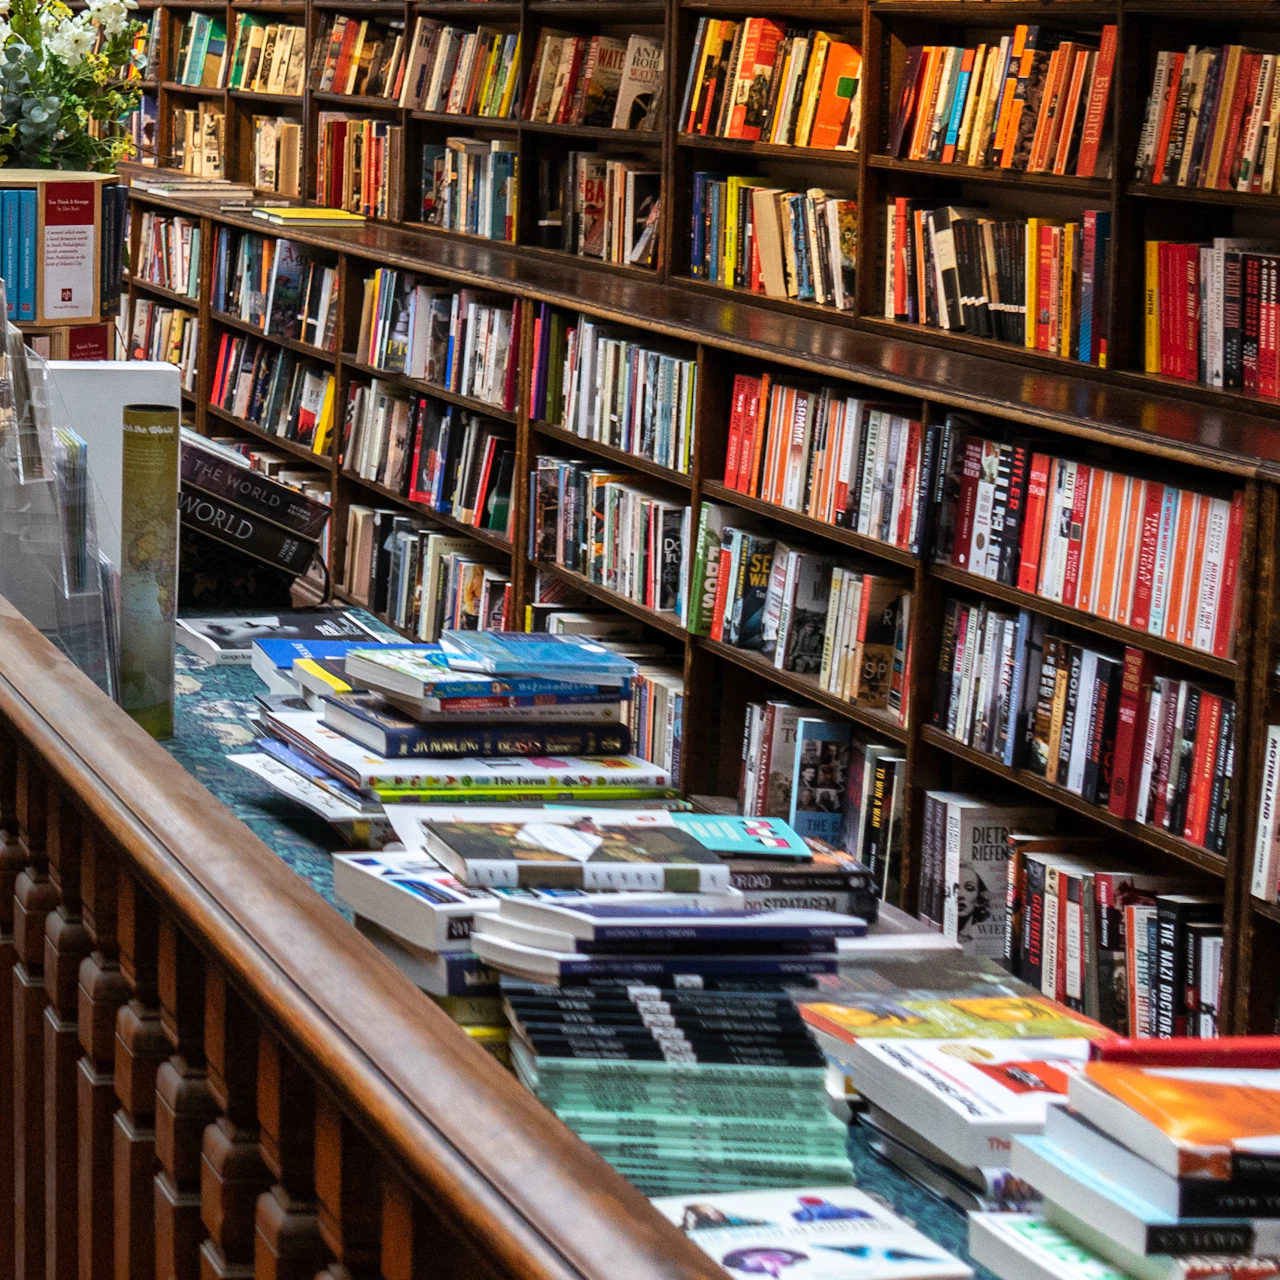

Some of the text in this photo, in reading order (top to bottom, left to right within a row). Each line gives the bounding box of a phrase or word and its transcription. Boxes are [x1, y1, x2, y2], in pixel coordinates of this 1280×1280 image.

[1255, 60, 1269, 106] DEIGHTON
[1083, 75, 1110, 145] Bismarck
[1269, 269, 1277, 307] GERMAN
[1268, 308, 1276, 350] REQUIEM
[792, 399, 808, 446] SOMME
[869, 423, 880, 465] GREAT
[192, 460, 282, 507] THE WORLD
[1009, 446, 1025, 510] HITLER
[1028, 485, 1046, 496] STALIN
[1030, 471, 1047, 481] HITLER
[1066, 472, 1075, 492] NOT
[179, 492, 254, 540] WORLD
[287, 508, 310, 522] EDITION
[289, 504, 312, 517] SECOND
[1163, 506, 1172, 534] WOMEN
[278, 539, 292, 559] TIMES
[285, 541, 300, 563] BOOKS
[1213, 515, 1225, 556] ANTONY
[1204, 562, 1219, 630] ARDENNES 1944
[1060, 656, 1082, 761] ADOLF HITLER
[756, 742, 771, 797] TOMMY'S
[875, 767, 885, 780] TO
[1204, 739, 1216, 779] ALLIANCE
[1263, 737, 1278, 821] MOTHERLAND
[494, 777, 546, 786] The Farm
[874, 780, 884, 798] WIN
[871, 808, 882, 828] WAR
[973, 827, 1009, 844] DIETR
[971, 846, 1009, 861] RIEFEN
[763, 897, 837, 912] STRATAGEM
[1004, 860, 1015, 958] DARKNESS GERMANY
[1029, 893, 1042, 965] GOEBBELS
[1047, 939, 1056, 989] HANGMAN
[1158, 923, 1175, 1040] THE NAZI DOCTORS
